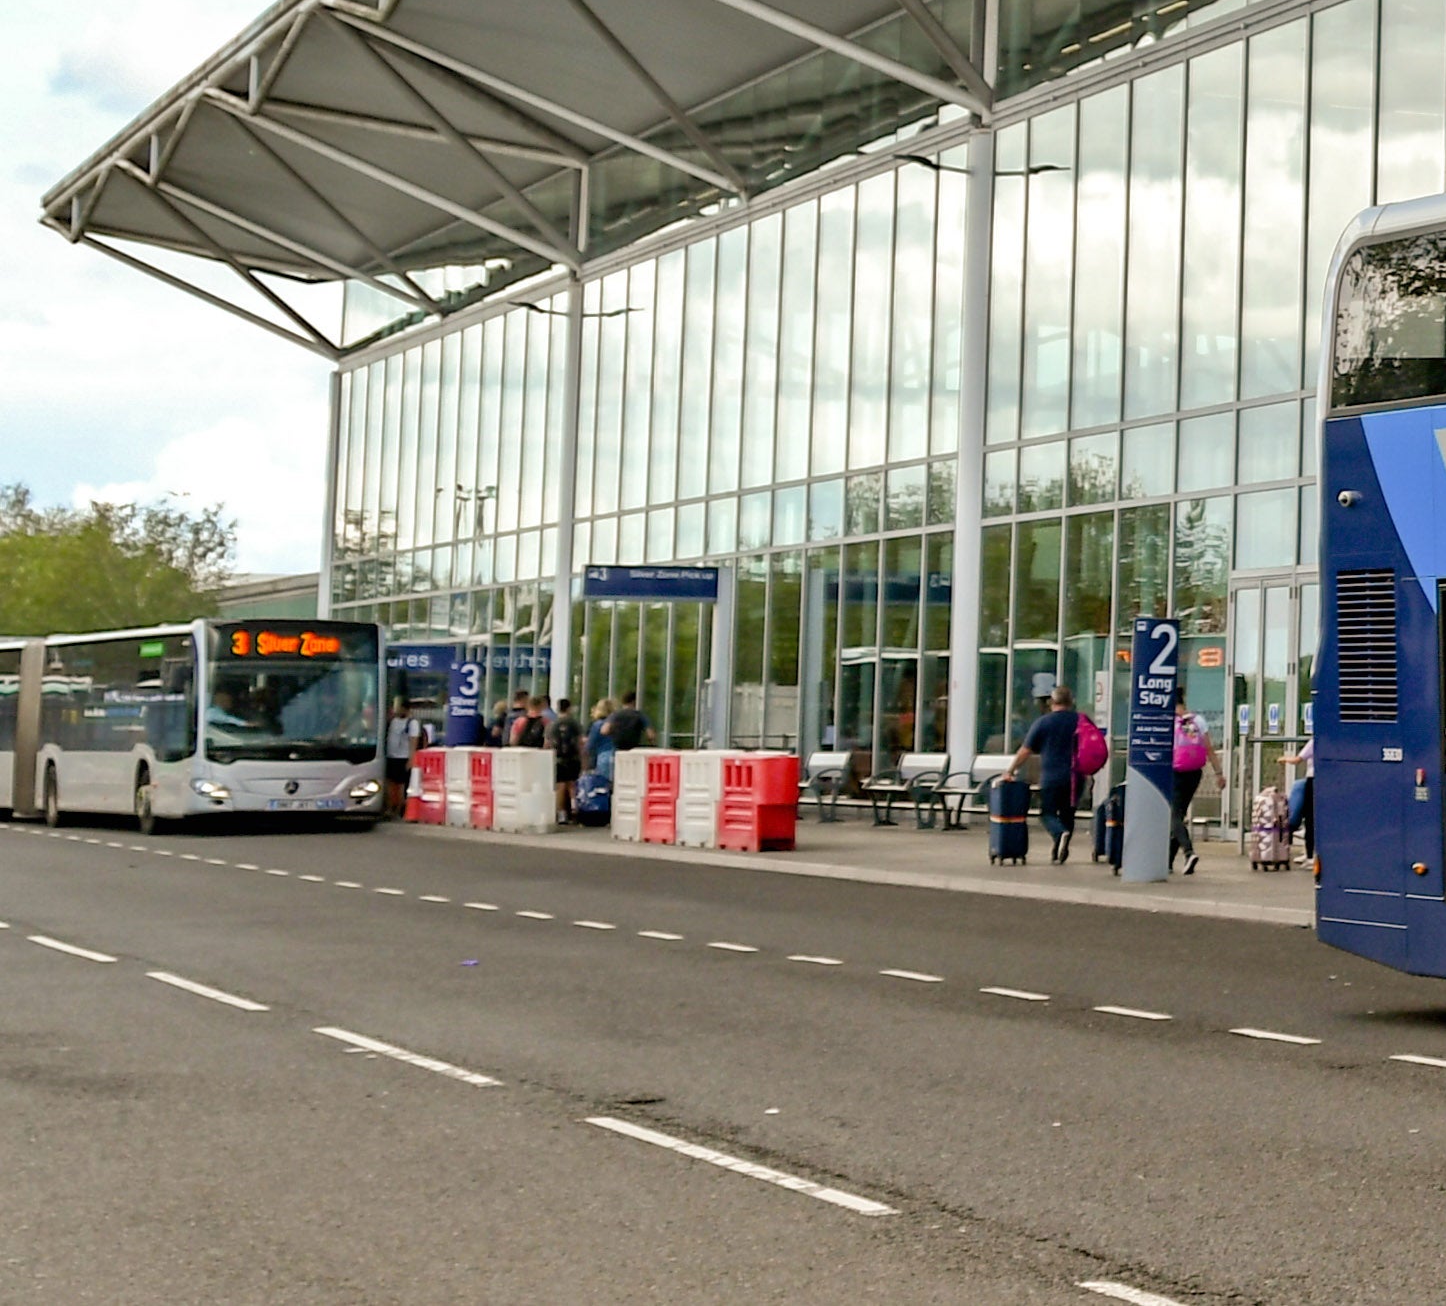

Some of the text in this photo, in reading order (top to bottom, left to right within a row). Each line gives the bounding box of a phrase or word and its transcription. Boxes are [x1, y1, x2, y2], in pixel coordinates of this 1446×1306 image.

[232, 630, 341, 656] 3 Silver Zone
[1149, 623, 1177, 675] 2
[459, 663, 479, 696] 3
[1138, 675, 1172, 693] Long
[450, 696, 477, 706] Silver
[1139, 692, 1170, 708] Stay
[451, 706, 475, 716] Zone
